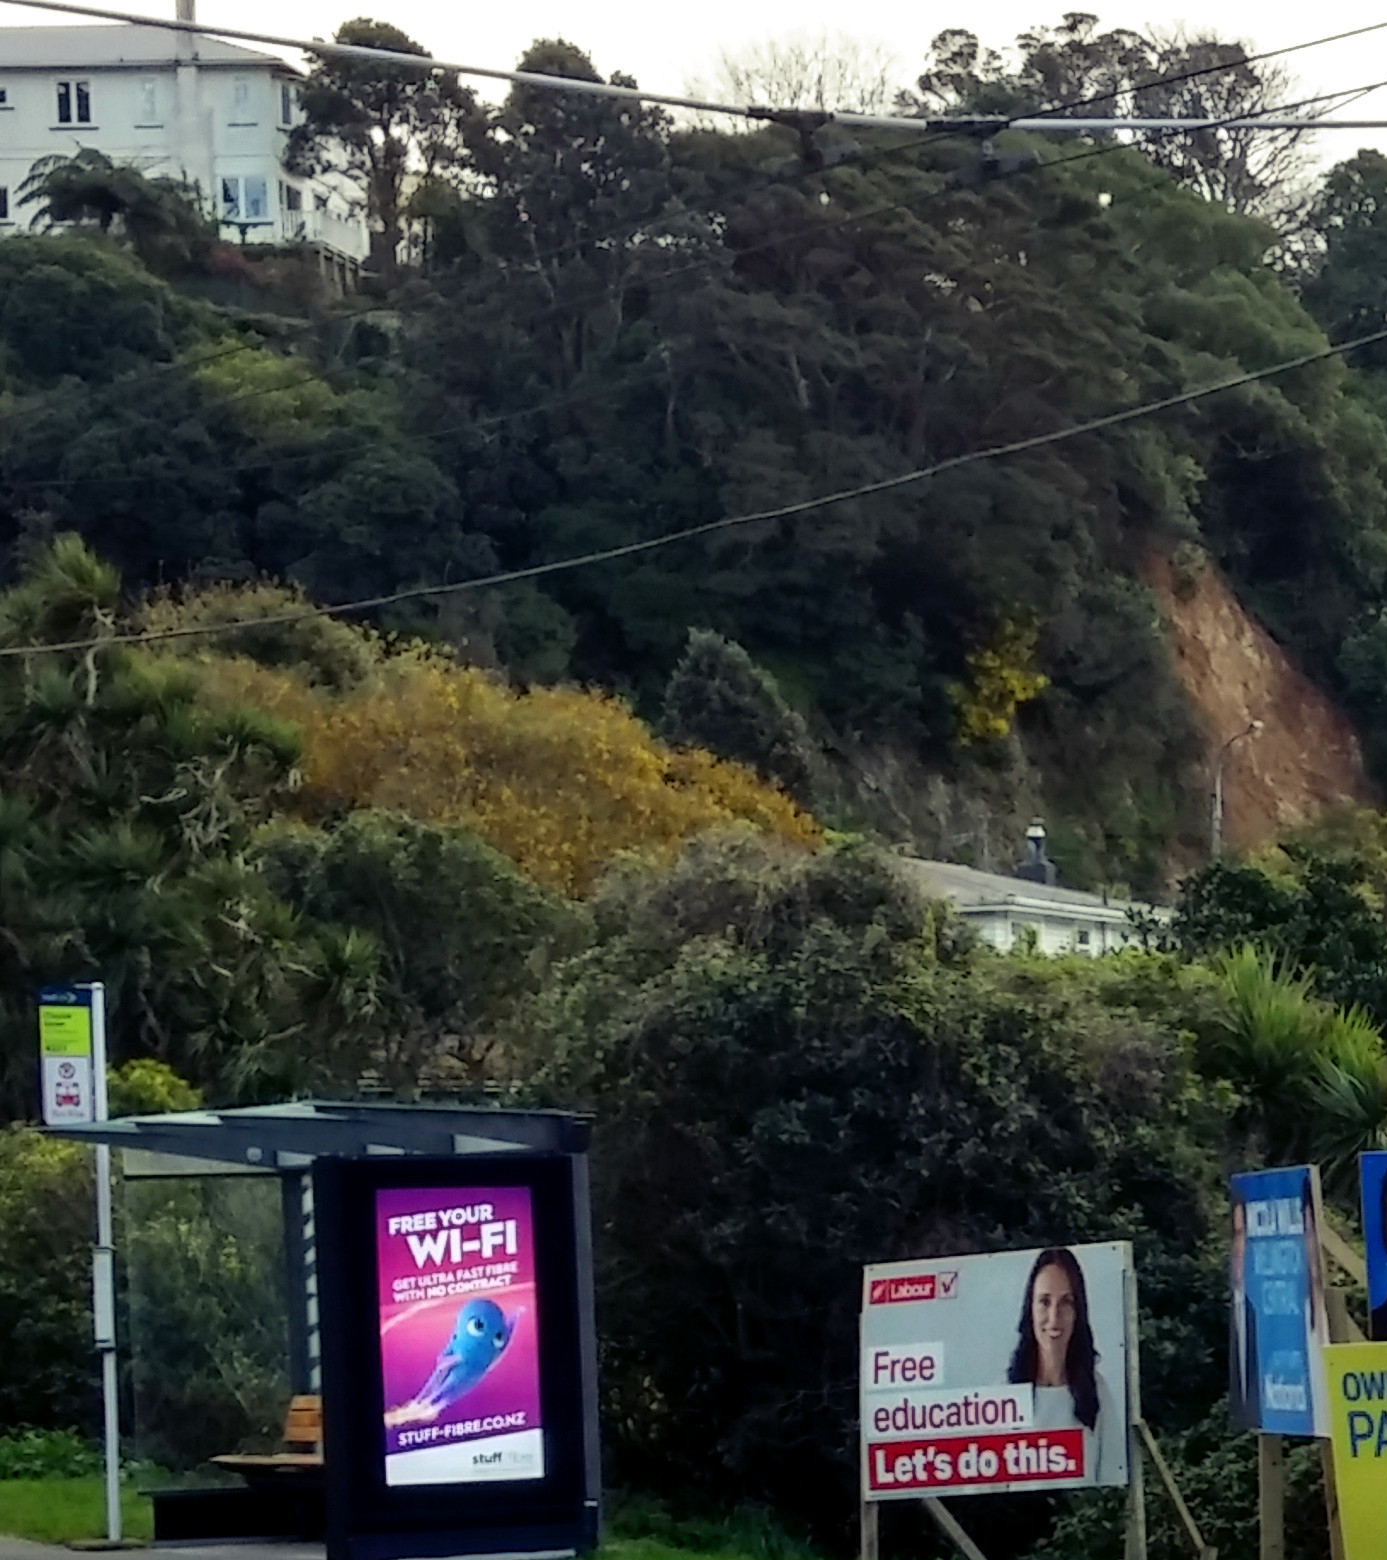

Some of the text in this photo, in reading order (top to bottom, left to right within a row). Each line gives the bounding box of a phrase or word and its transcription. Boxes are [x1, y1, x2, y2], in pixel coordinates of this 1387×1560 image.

[388, 1203, 494, 1236] FREE YOUR
[406, 1219, 518, 1270] WI-FI
[392, 1260, 519, 1291] GET ULTRA FAST FIBRE
[393, 1273, 513, 1304] WITH NO CONTRACT
[889, 1278, 934, 1299] Labour
[873, 1351, 936, 1384] Free
[397, 1411, 527, 1447] STUFF-FIBRE.CO.NZ
[873, 1392, 1025, 1433] education.
[472, 1451, 502, 1464] stuff
[875, 1438, 1077, 1484] Let's do this.
